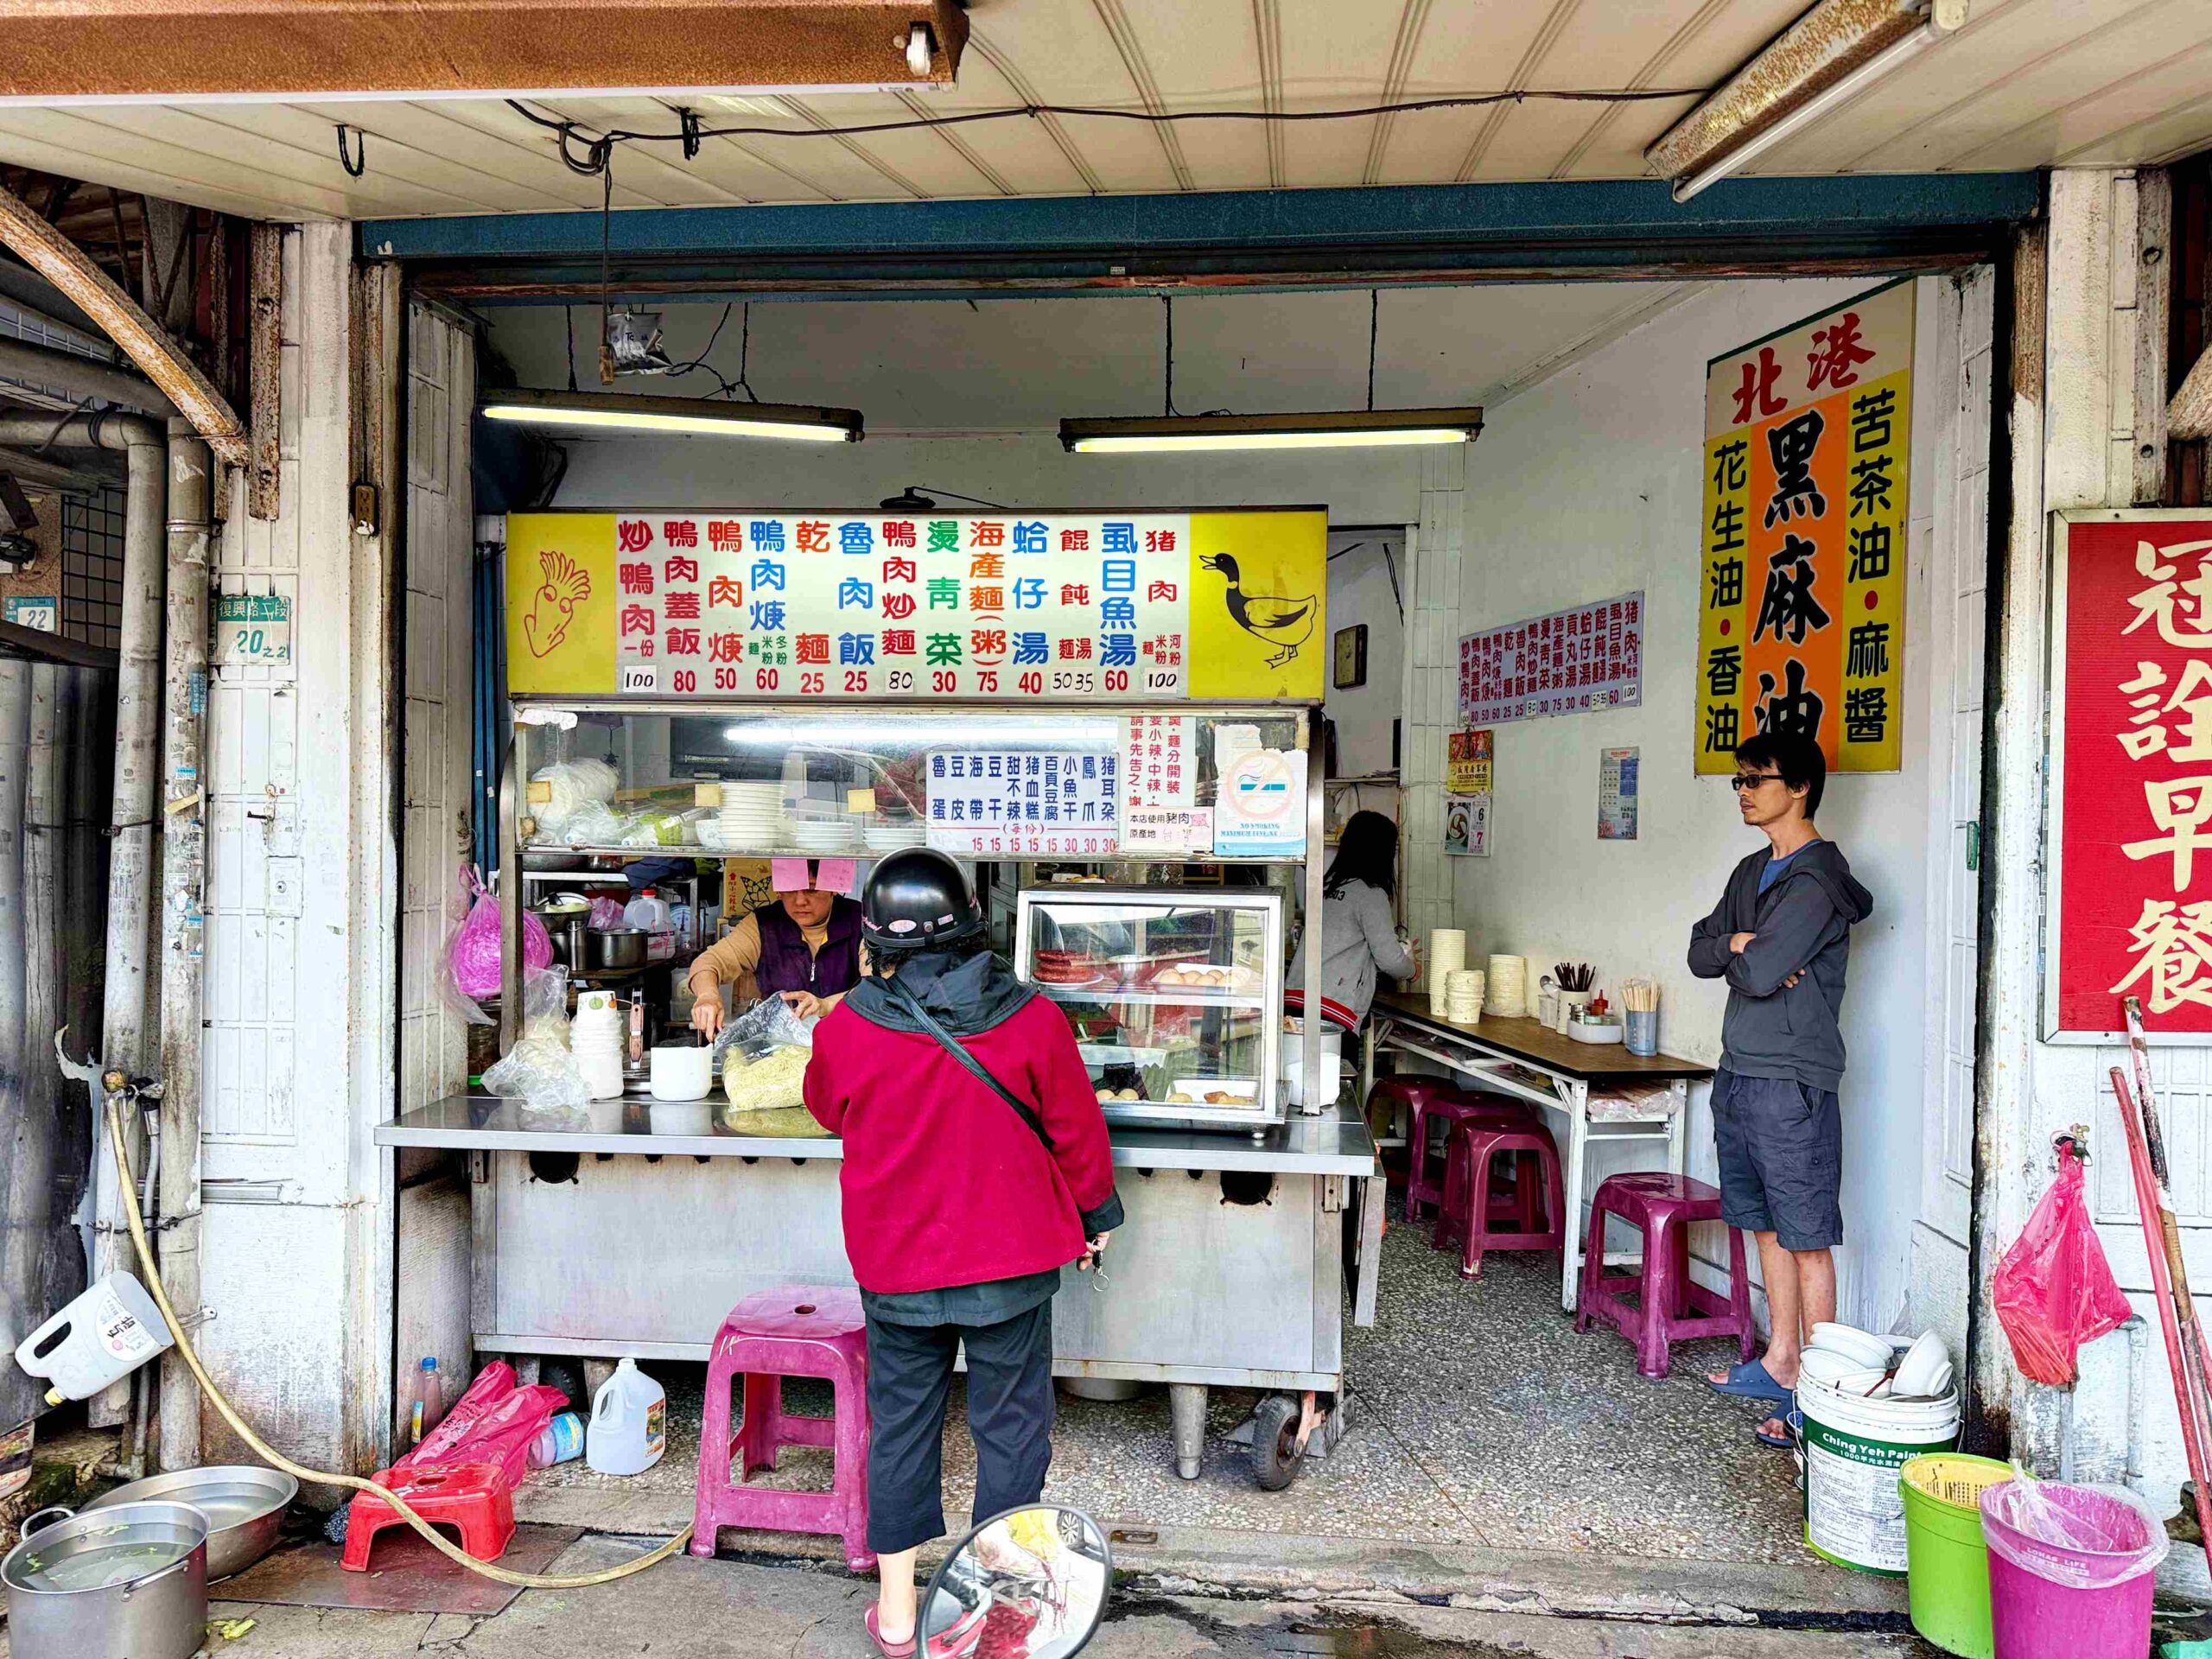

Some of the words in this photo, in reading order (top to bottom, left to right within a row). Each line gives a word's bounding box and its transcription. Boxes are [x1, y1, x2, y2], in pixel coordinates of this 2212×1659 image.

[1732, 313, 1876, 424] 北港
[1848, 388, 1896, 583] 苦茶油
[1709, 440, 1749, 610] 花生油
[1752, 410, 1832, 737] 黑麻油
[664, 520, 701, 654] 鴨肉蓋飯
[838, 522, 874, 665] 魯肉飯
[881, 520, 917, 656] 鴨肉炒麵
[926, 521, 962, 666] 燙青菜
[1012, 521, 1049, 665] 蛤仔湯
[1099, 523, 1138, 667] 虱目魚湯
[27, 609, 48, 628] 22
[1566, 613, 1578, 689] 貢丸湯
[626, 672, 654, 688] 100
[673, 671, 696, 692] 80
[715, 668, 736, 690] 50
[756, 668, 779, 690] 60
[800, 672, 824, 694] 25
[844, 671, 868, 692] 25
[888, 671, 912, 690] 80
[932, 671, 957, 692] 30
[976, 671, 998, 692] 75
[1019, 672, 1042, 694] 40
[1052, 672, 1072, 689] 50
[1075, 672, 1094, 692] 35
[1105, 670, 1128, 691] 60
[1148, 673, 1177, 688] 100
[1845, 620, 1890, 743] 麻醬
[1580, 695, 1589, 708] 40
[1609, 690, 1618, 704] 60
[1624, 687, 1636, 698] 100
[1704, 645, 1741, 753] 香油
[1503, 706, 1511, 718] 25
[1516, 704, 1523, 716] 25
[1540, 700, 1548, 713] 30
[1553, 698, 1561, 710] 75
[1566, 696, 1575, 709] 30
[1471, 711, 1478, 722] 80
[1481, 709, 1489, 721] 50
[1492, 708, 1500, 719] 60
[1007, 755, 1020, 821] 甜不辣
[1045, 755, 1058, 821] 百頁豆腐
[1063, 755, 1077, 821] 小魚干
[1129, 812, 1190, 824] 本店使用豬肉
[1478, 807, 1484, 822] 6
[1129, 829, 1156, 839] 原產地
[1477, 831, 1484, 845] 7
[971, 837, 982, 852] 15
[990, 837, 1001, 852] 15
[1009, 837, 1020, 852] 15
[1027, 837, 1039, 852] 15
[1046, 837, 1058, 852] 15
[1065, 837, 1077, 852] 30
[1084, 837, 1097, 852] 30
[1102, 837, 1116, 852] 30
[1822, 1433, 1857, 1452] Ching
[1859, 1444, 1885, 1458] Yeh
[2064, 1559, 2087, 1569] LIFE
